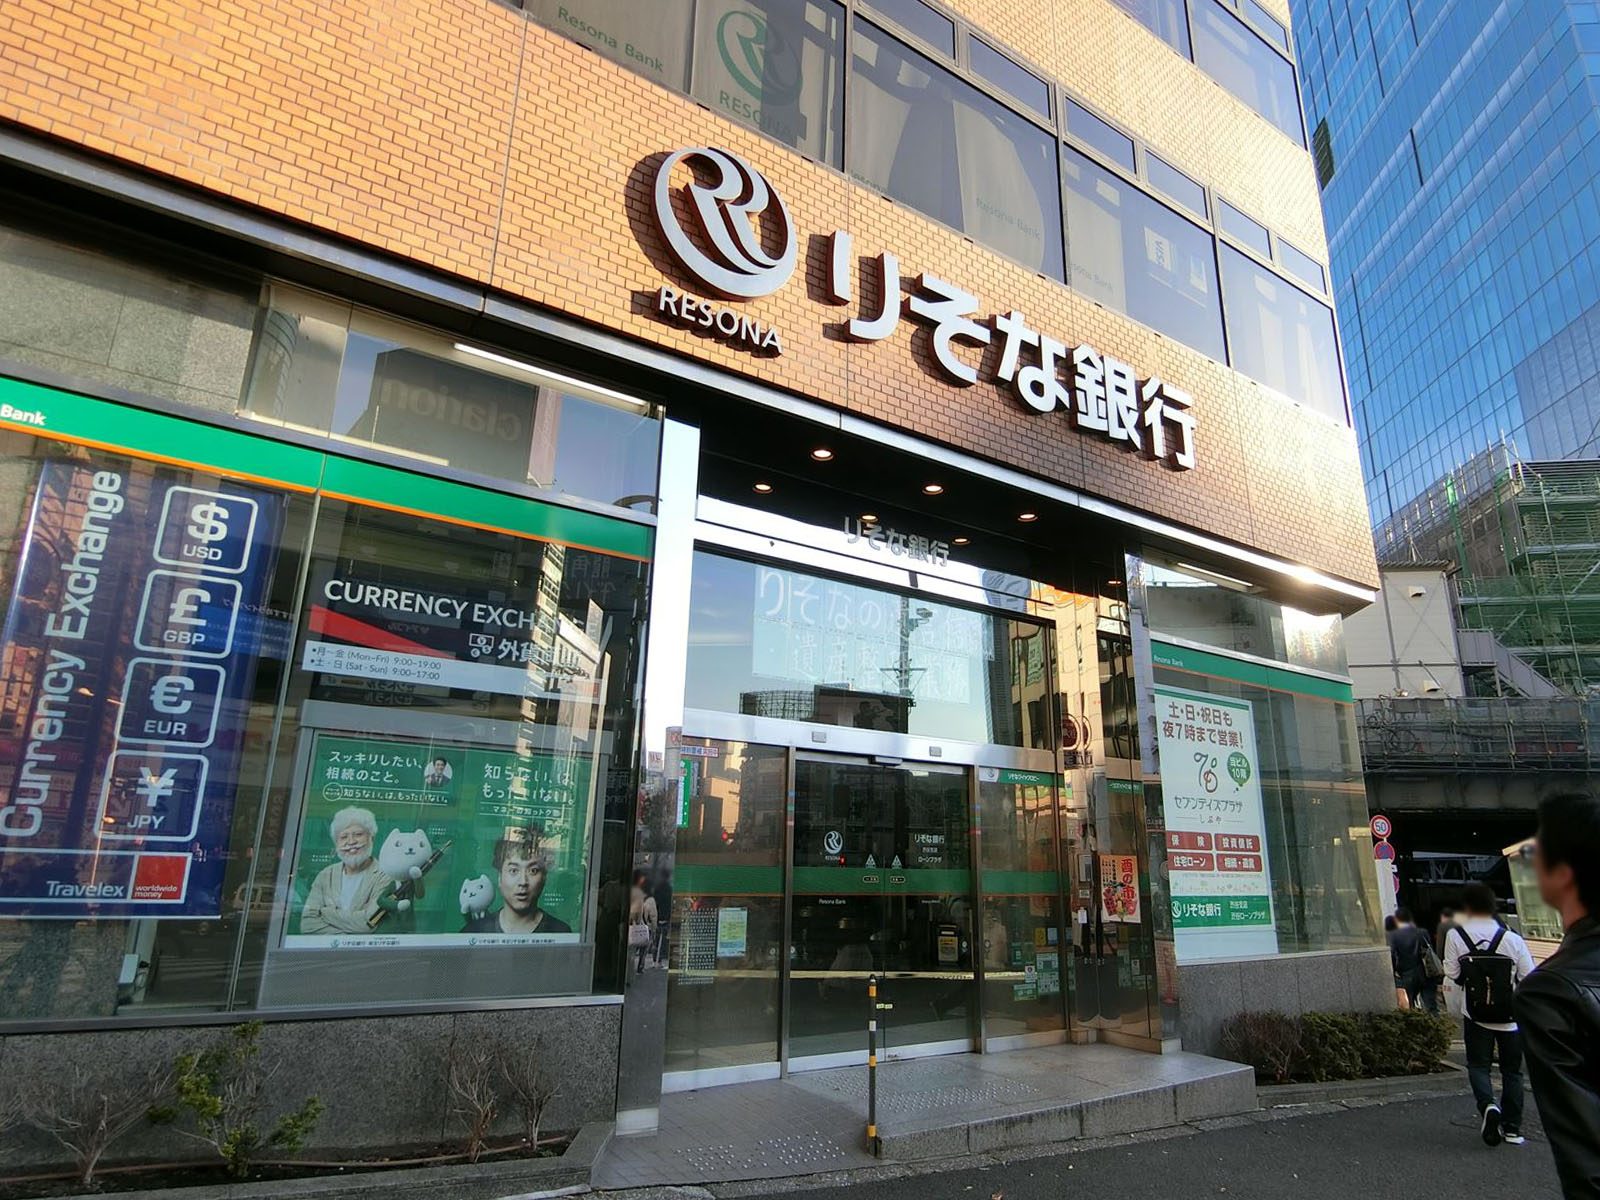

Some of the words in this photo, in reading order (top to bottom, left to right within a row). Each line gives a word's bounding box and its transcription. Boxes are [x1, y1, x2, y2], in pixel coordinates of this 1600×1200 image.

[557, 7, 619, 49] Resona
[624, 43, 665, 73] Bank
[658, 285, 783, 356] RESONA
[826, 229, 1197, 471] りそな銀行
[0, 404, 46, 427] Bank
[843, 515, 951, 568] りそな銀行
[183, 543, 222, 561] USD
[323, 579, 469, 620] CURRENCY
[163, 630, 206, 645] GBP
[0, 648, 86, 838] Currency
[43, 470, 124, 641] Exchange
[393, 656, 442, 670] 9:00-19:00
[391, 668, 440, 680] 9:00-17:00
[143, 719, 188, 736] EUR
[127, 815, 166, 830] JPY
[1375, 821, 1387, 832] 50
[46, 879, 125, 898] Travelex
[134, 891, 164, 900] money
[135, 884, 179, 894] worldwide
[1183, 903, 1222, 917] りそな銀行
